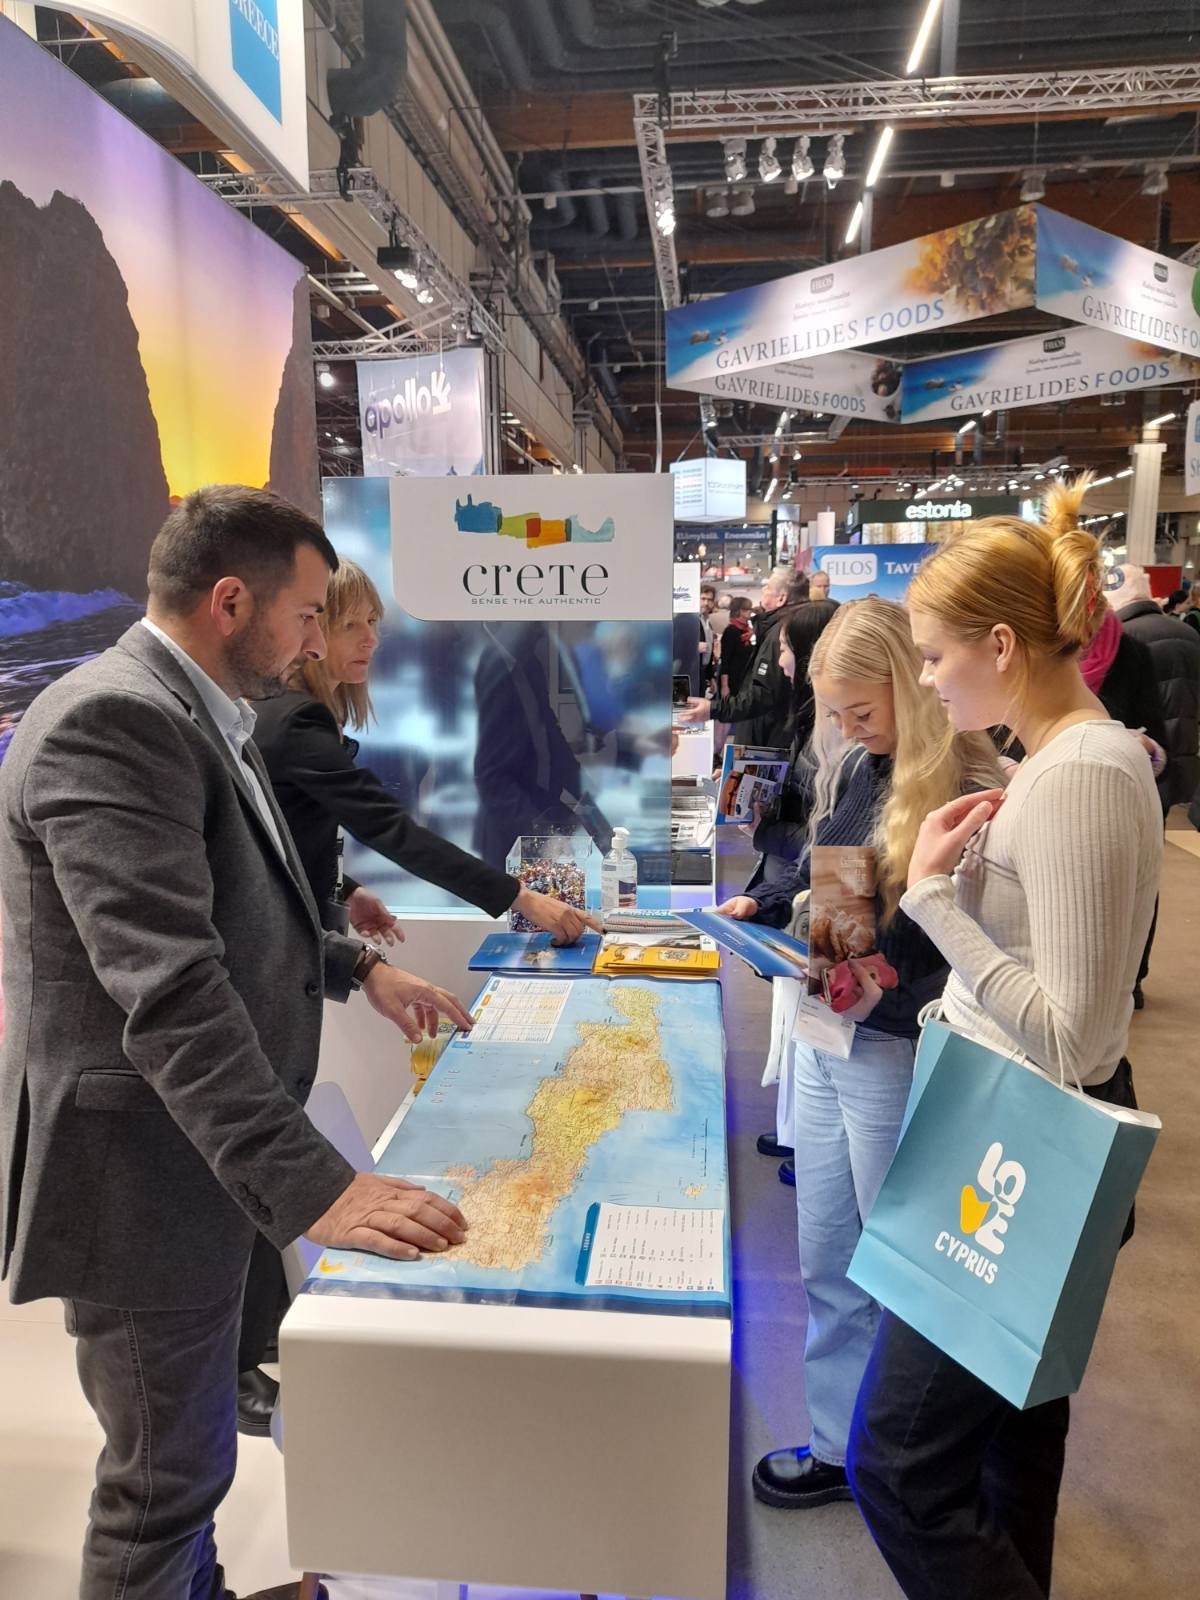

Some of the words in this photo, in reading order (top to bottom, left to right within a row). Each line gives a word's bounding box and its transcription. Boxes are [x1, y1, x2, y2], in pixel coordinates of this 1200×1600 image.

[231, 0, 279, 61] REECE
[716, 319, 858, 369] GAVRIELIDES
[865, 299, 944, 336] FOODS
[1082, 295, 1179, 343] GAVRIELIDES
[1182, 327, 1200, 349] FO
[365, 377, 431, 439] apollo
[715, 375, 819, 406] GAVRIELIDES
[822, 392, 865, 413] FOODS
[951, 375, 1089, 411] GAVRIELIDES
[1095, 361, 1170, 388] FOODS
[905, 500, 972, 520] estonia
[826, 560, 873, 576] FILOS
[884, 562, 921, 575] TAVE
[934, 1231, 998, 1285] CYPRUS
